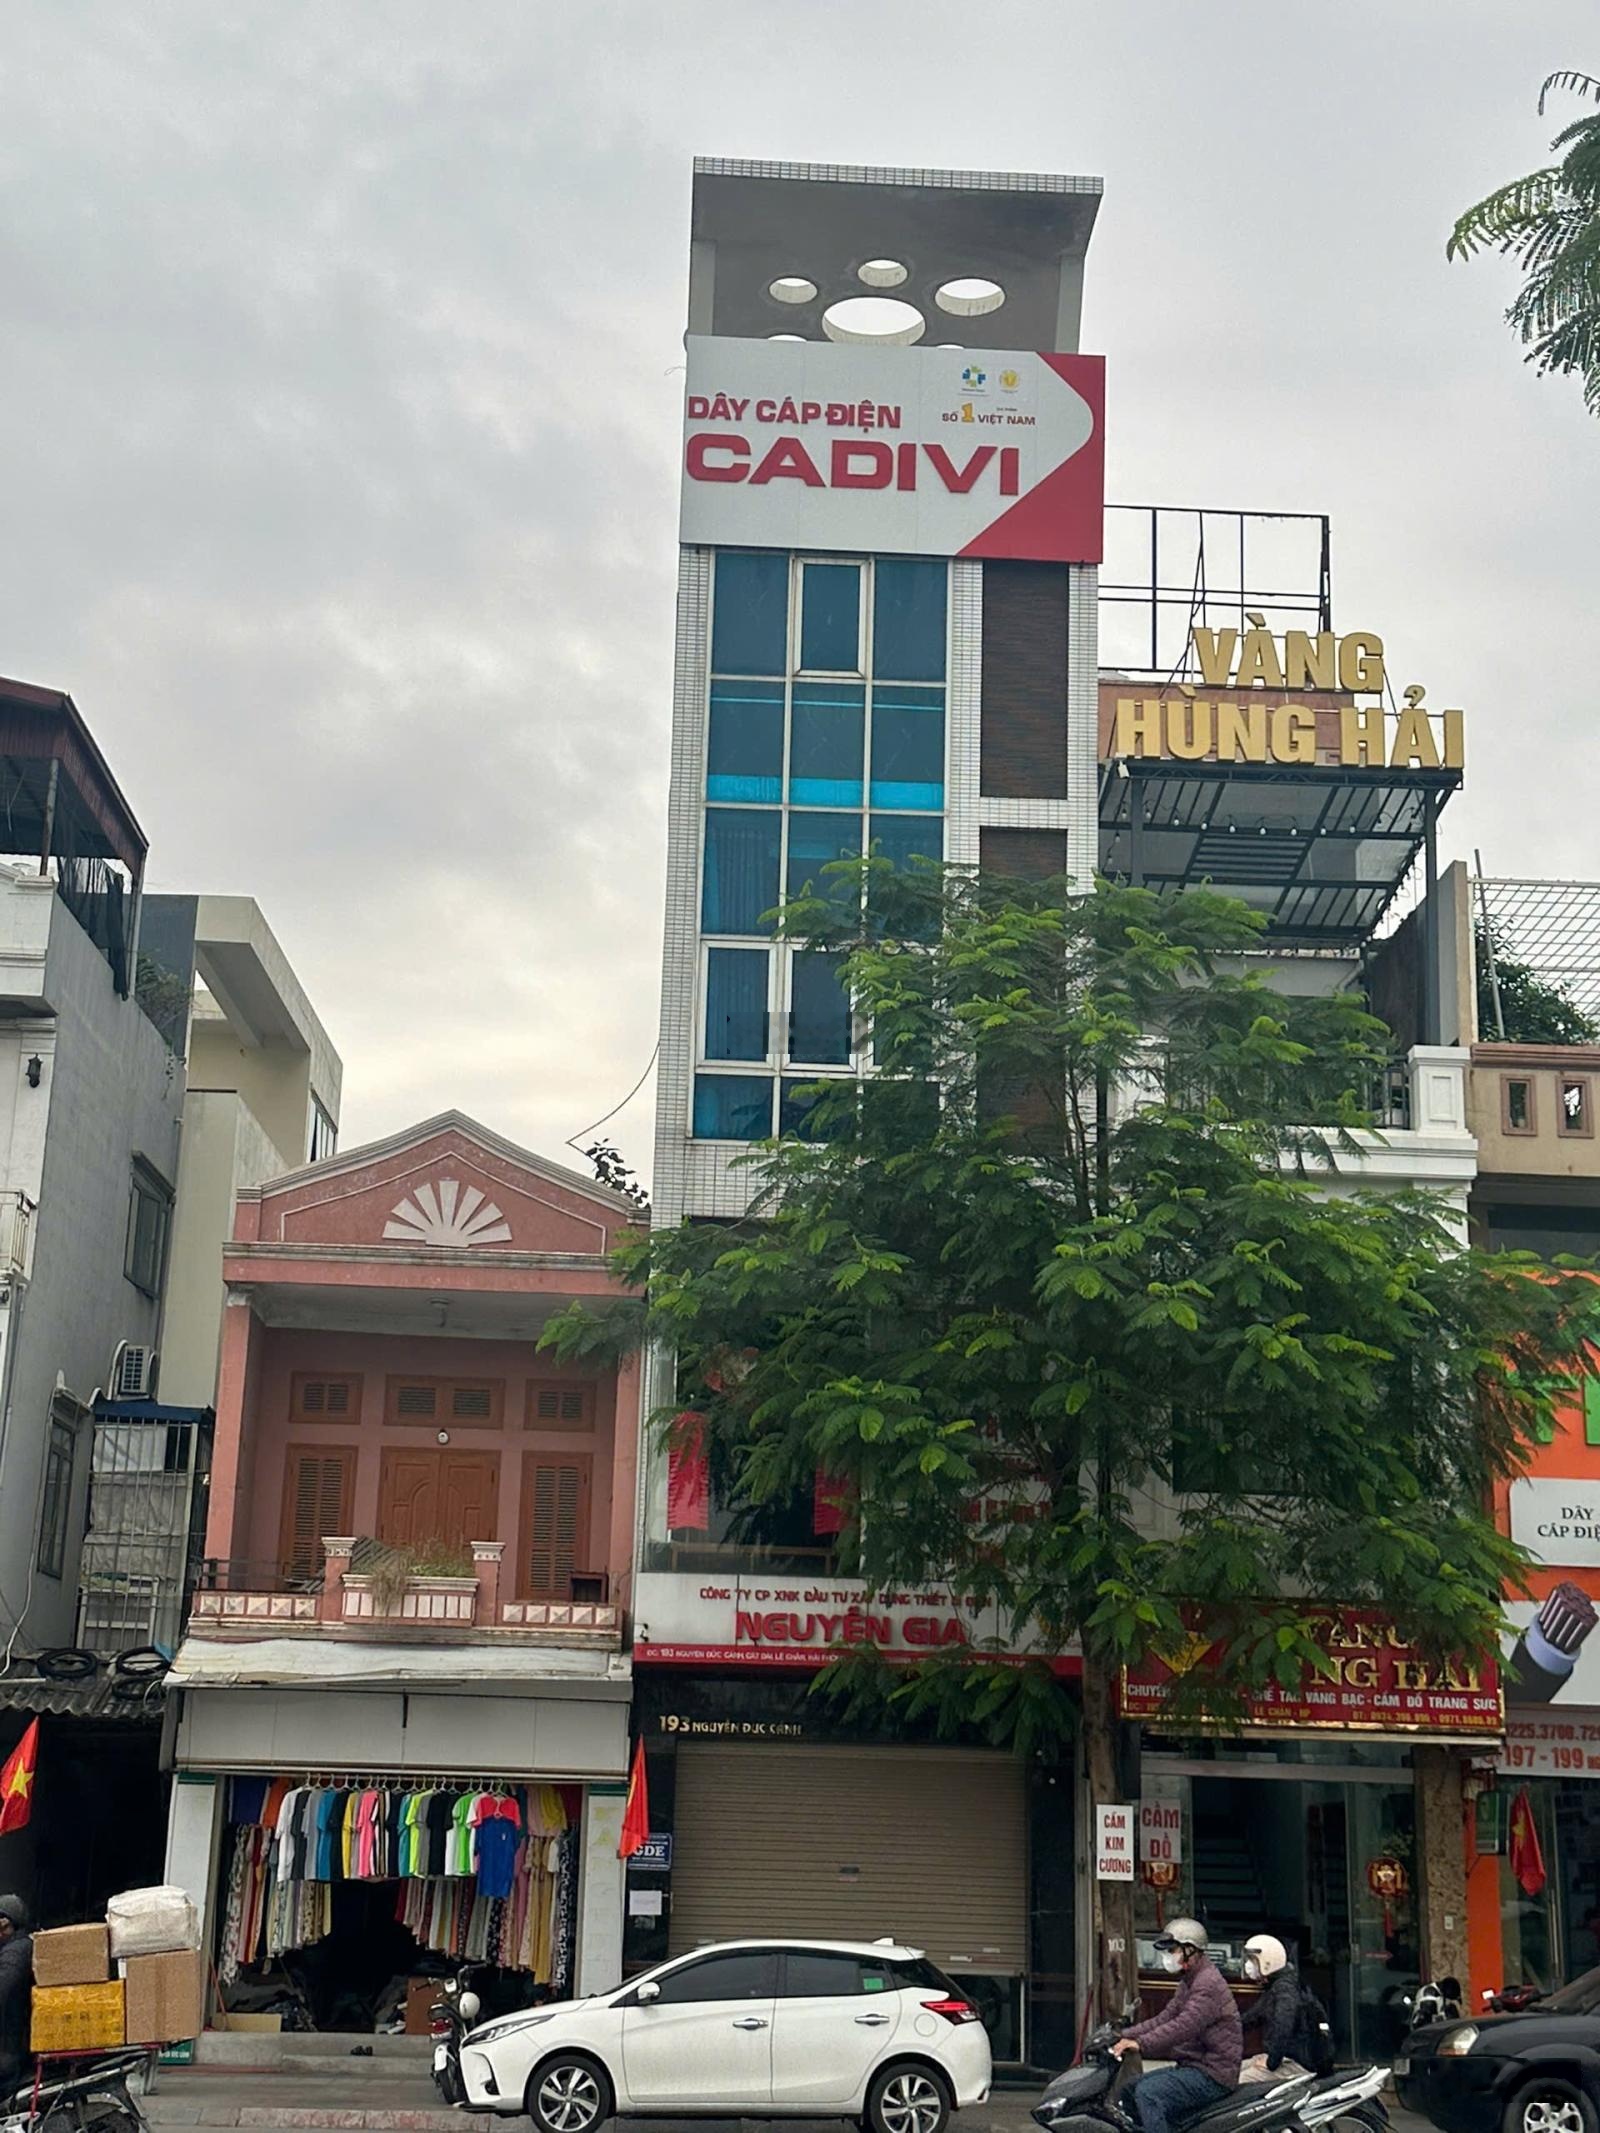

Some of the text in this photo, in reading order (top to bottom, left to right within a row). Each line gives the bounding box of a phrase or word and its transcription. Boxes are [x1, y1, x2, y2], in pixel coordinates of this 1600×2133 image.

[688, 392, 900, 433] DÂY CÁP ĐIỆN
[942, 402, 1036, 426] SỐ 1 VIỆT NAM
[686, 433, 1019, 496] CADIVI
[1192, 612, 1384, 693] VÀNG
[1116, 684, 1464, 769] HÙNG HẢI
[1561, 1505, 1594, 1520] DÂY
[1537, 1522, 1570, 1538] CÁP
[700, 1586, 730, 1600] CÔNG
[735, 1588, 751, 1601] TY
[755, 1589, 771, 1601] CP
[774, 1590, 800, 1602] XNK
[736, 1605, 968, 1646] NGUYỄN GIA
[1341, 1692, 1365, 1708] BẠC
[1428, 1696, 1468, 1711] TRANG
[659, 1715, 690, 1732] 193
[1505, 1745, 1535, 1768] 197
[1552, 1747, 1583, 1769] 199
[1105, 1836, 1125, 1851] KIM
